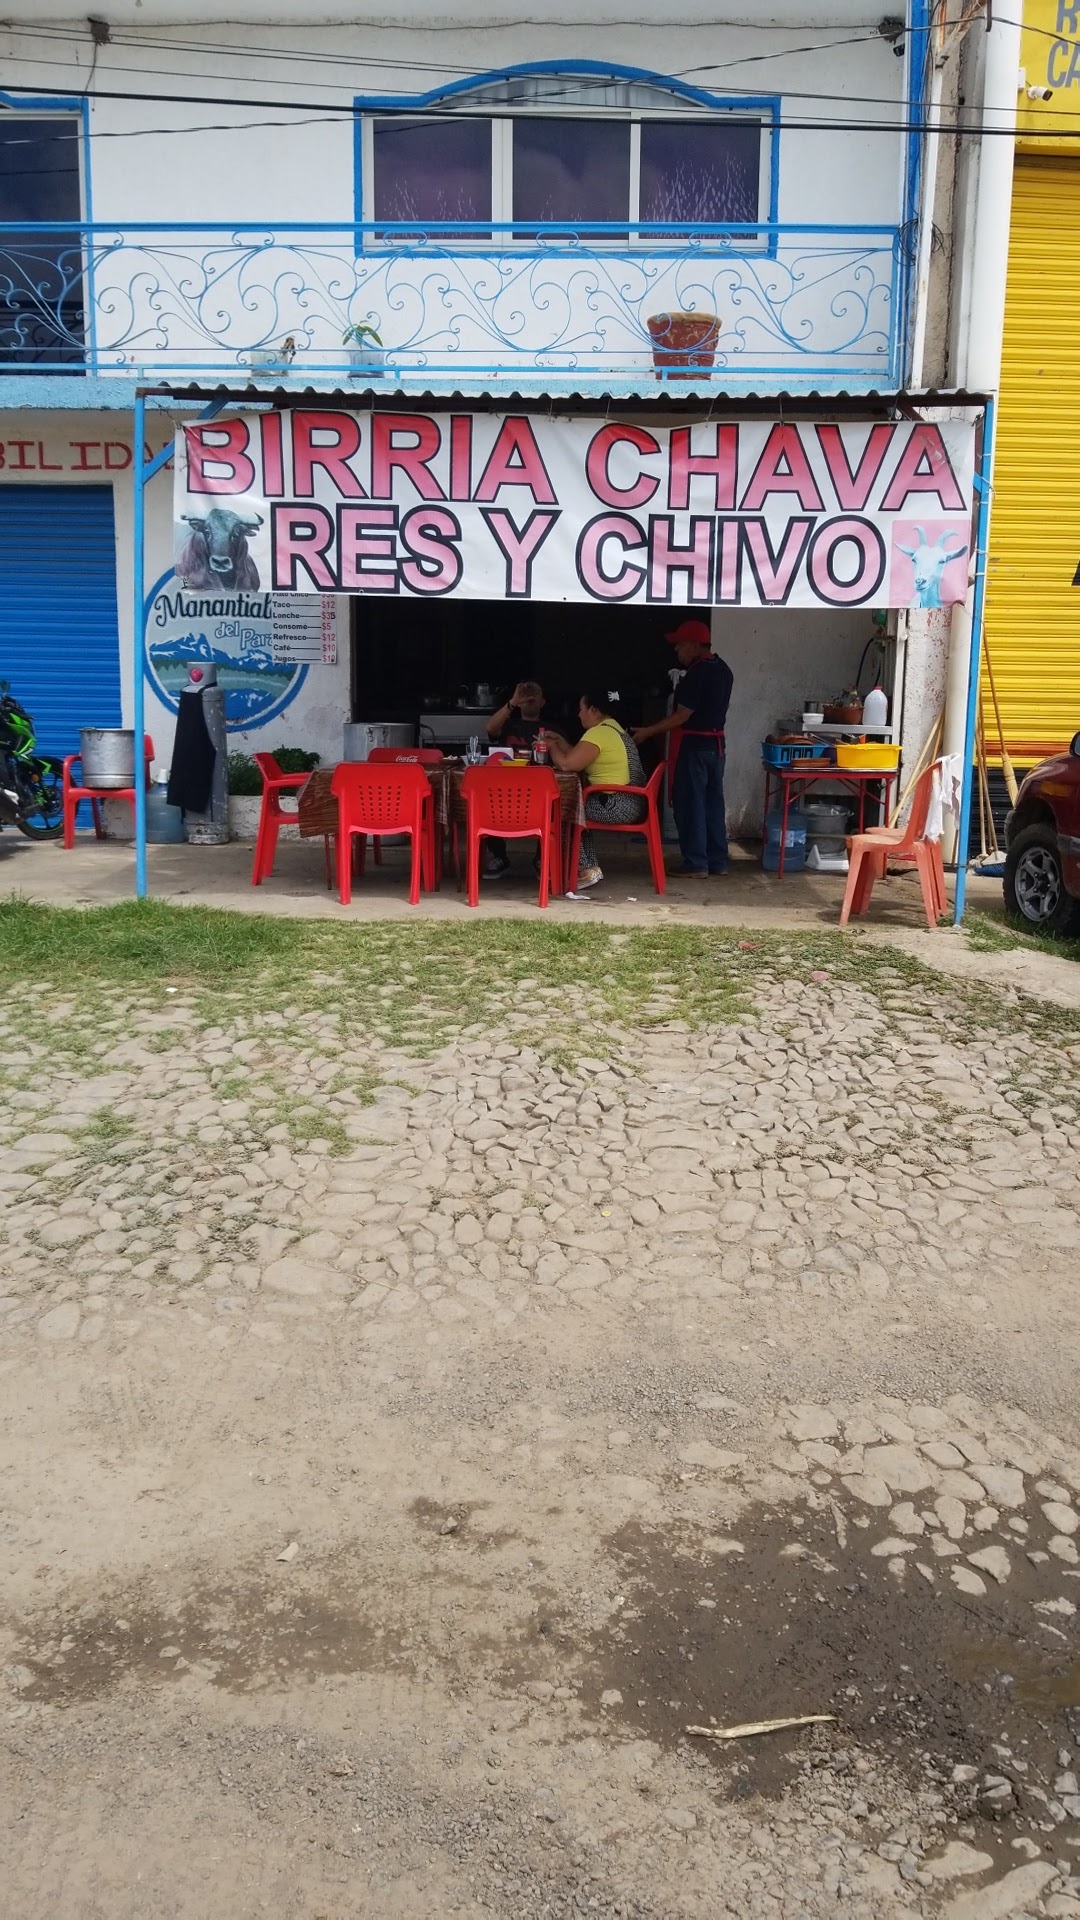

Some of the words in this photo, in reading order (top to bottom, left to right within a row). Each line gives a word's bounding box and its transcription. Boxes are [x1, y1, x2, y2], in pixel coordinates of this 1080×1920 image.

[0, 441, 174, 471] ILID
[184, 408, 559, 505] BIRRIA
[585, 423, 967, 512] CHAVA
[270, 501, 463, 596] RES
[478, 506, 563, 598] Y
[575, 511, 886, 607] CHIVO
[154, 592, 272, 627] Manantial
[321, 601, 336, 609] $12
[215, 621, 240, 638] del
[273, 622, 308, 630] Consomé
[321, 622, 332, 631] $5
[273, 633, 307, 641] Refresco
[322, 633, 336, 641] $12
[273, 643, 292, 651] Café
[322, 643, 336, 652] $10
[273, 655, 296, 663] Jugos
